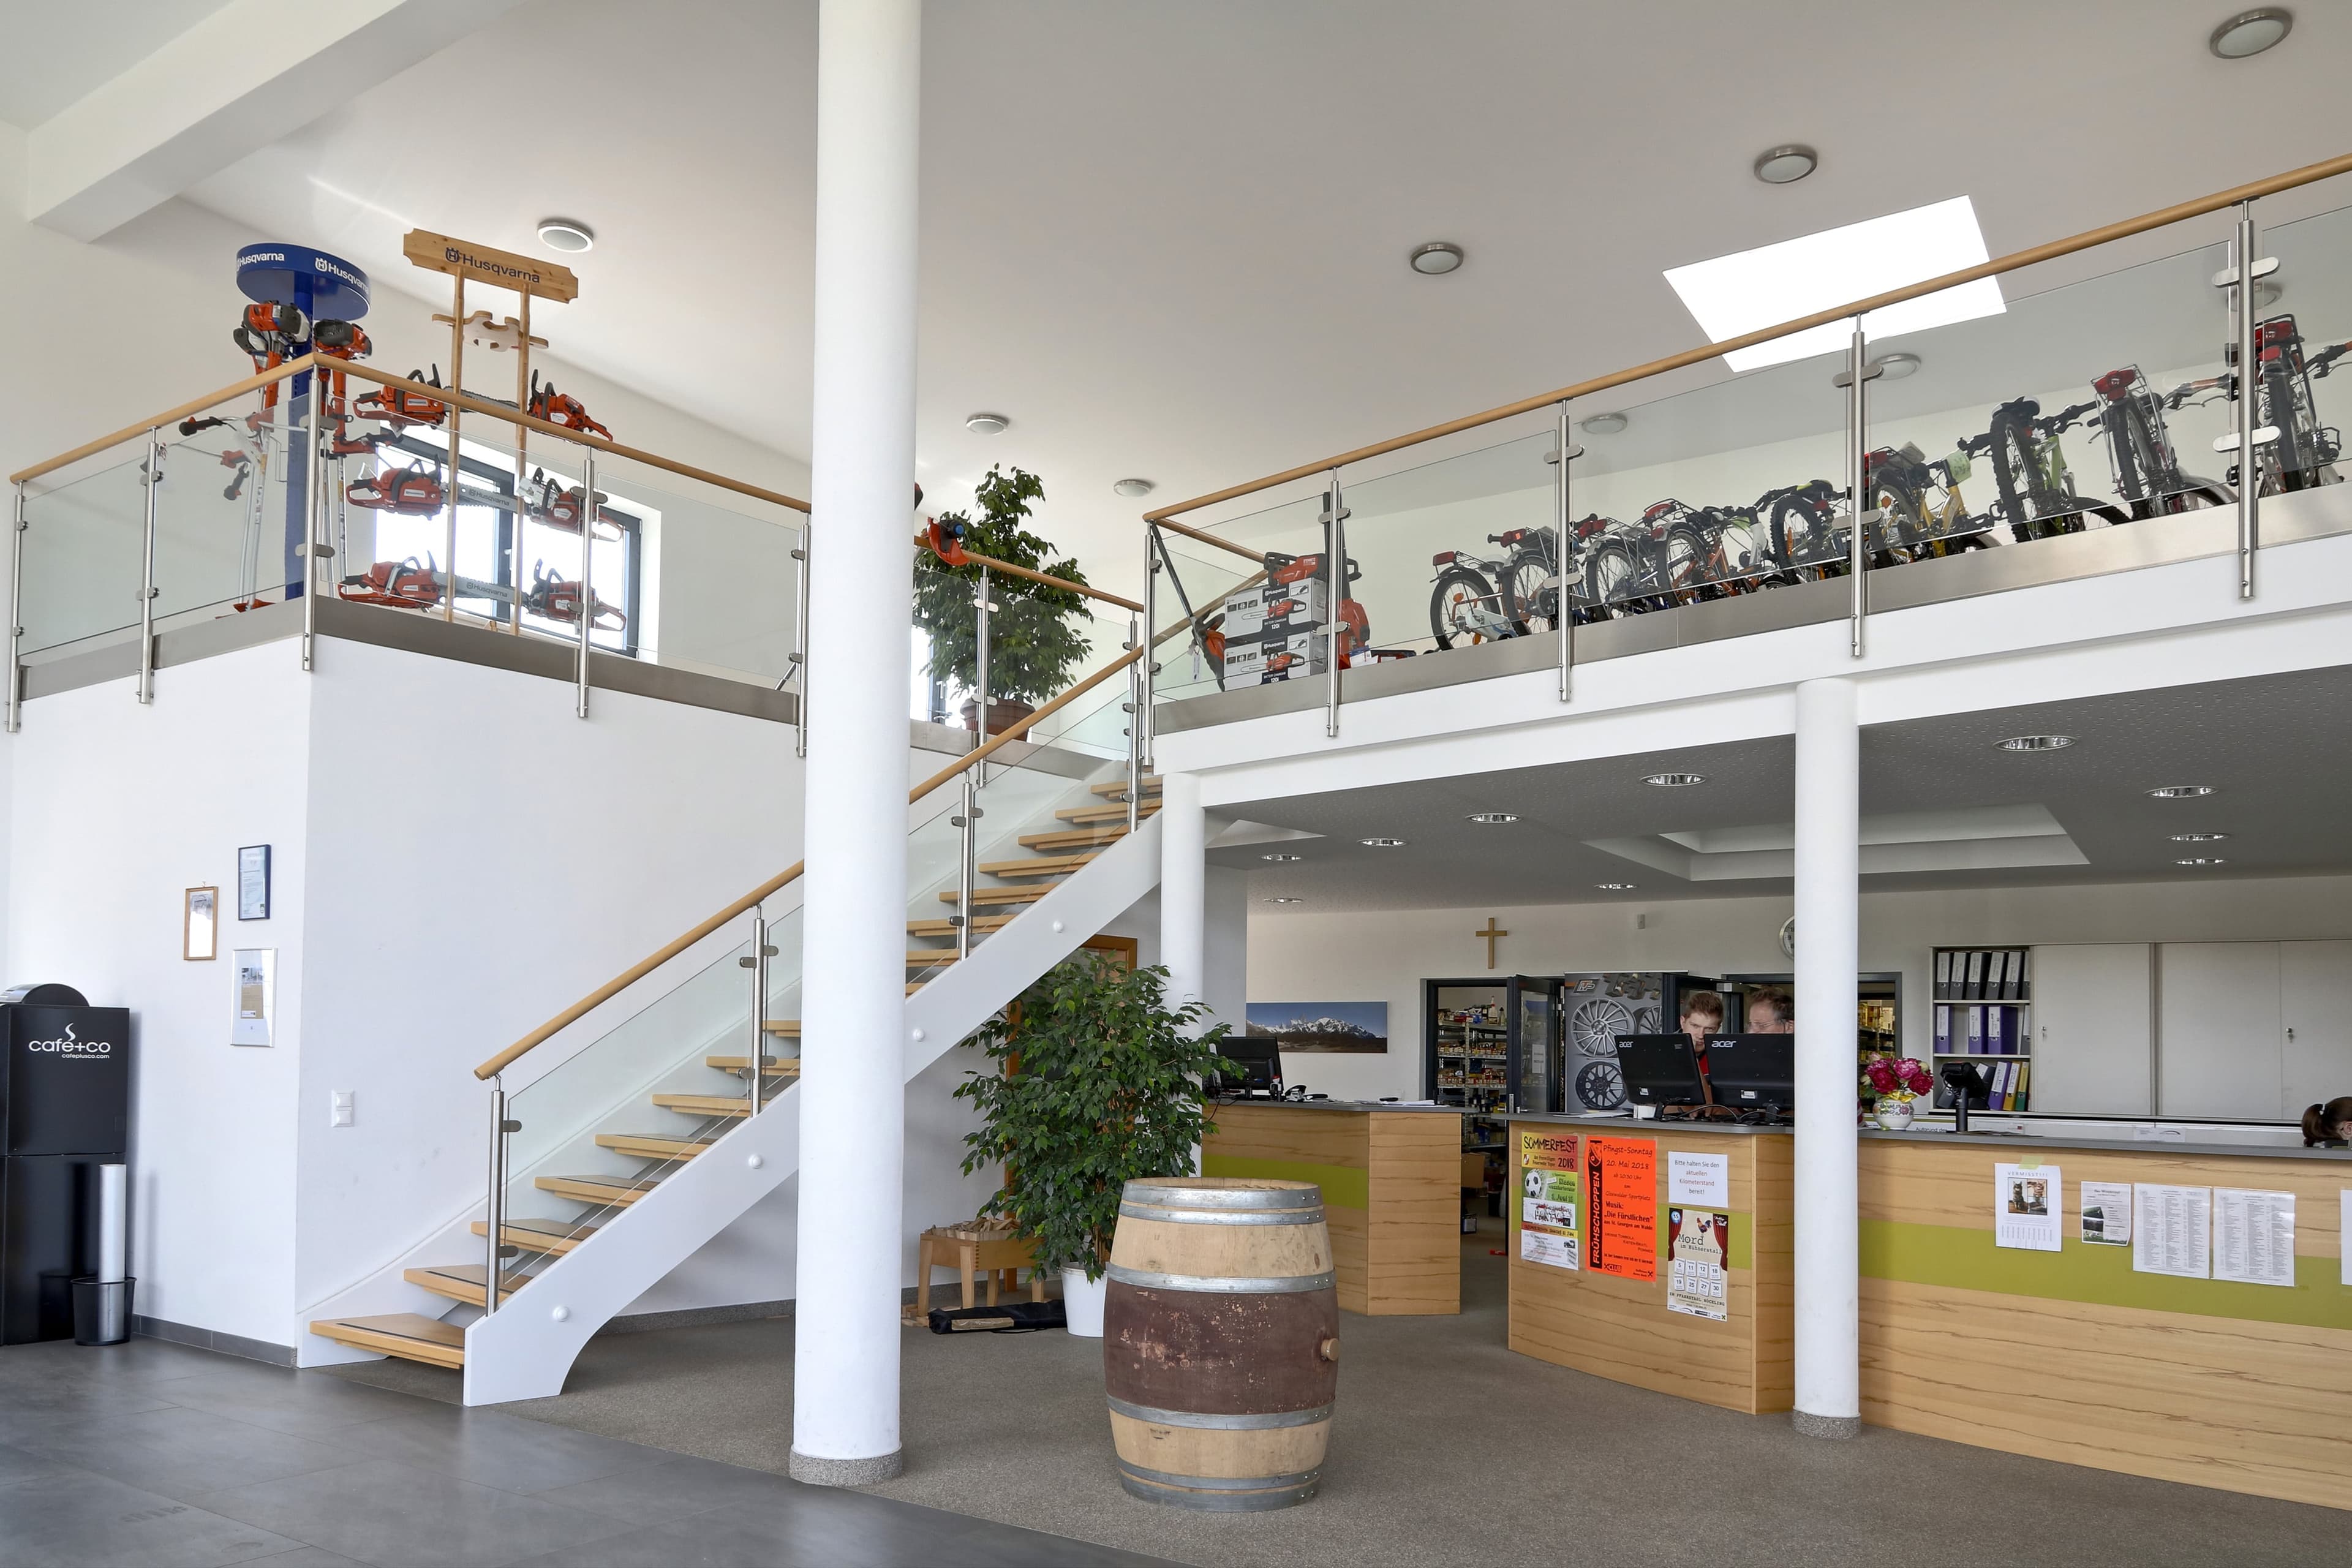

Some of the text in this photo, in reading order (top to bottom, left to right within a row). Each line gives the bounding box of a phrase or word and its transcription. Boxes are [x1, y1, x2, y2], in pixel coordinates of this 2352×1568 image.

[239, 252, 285, 265] Husqvarna
[462, 252, 540, 284] Husqvarna
[476, 491, 510, 506] Husqvarna
[473, 583, 508, 598] Husqvarna
[1524, 1136, 1577, 1153] SOMMERFEST
[1604, 1144, 1653, 1158] Pfingst-Sonntag
[1558, 1158, 1574, 1169] 2018
[1678, 1234, 1703, 1245] Mord
[1689, 1245, 1722, 1254] Hühnerstall
